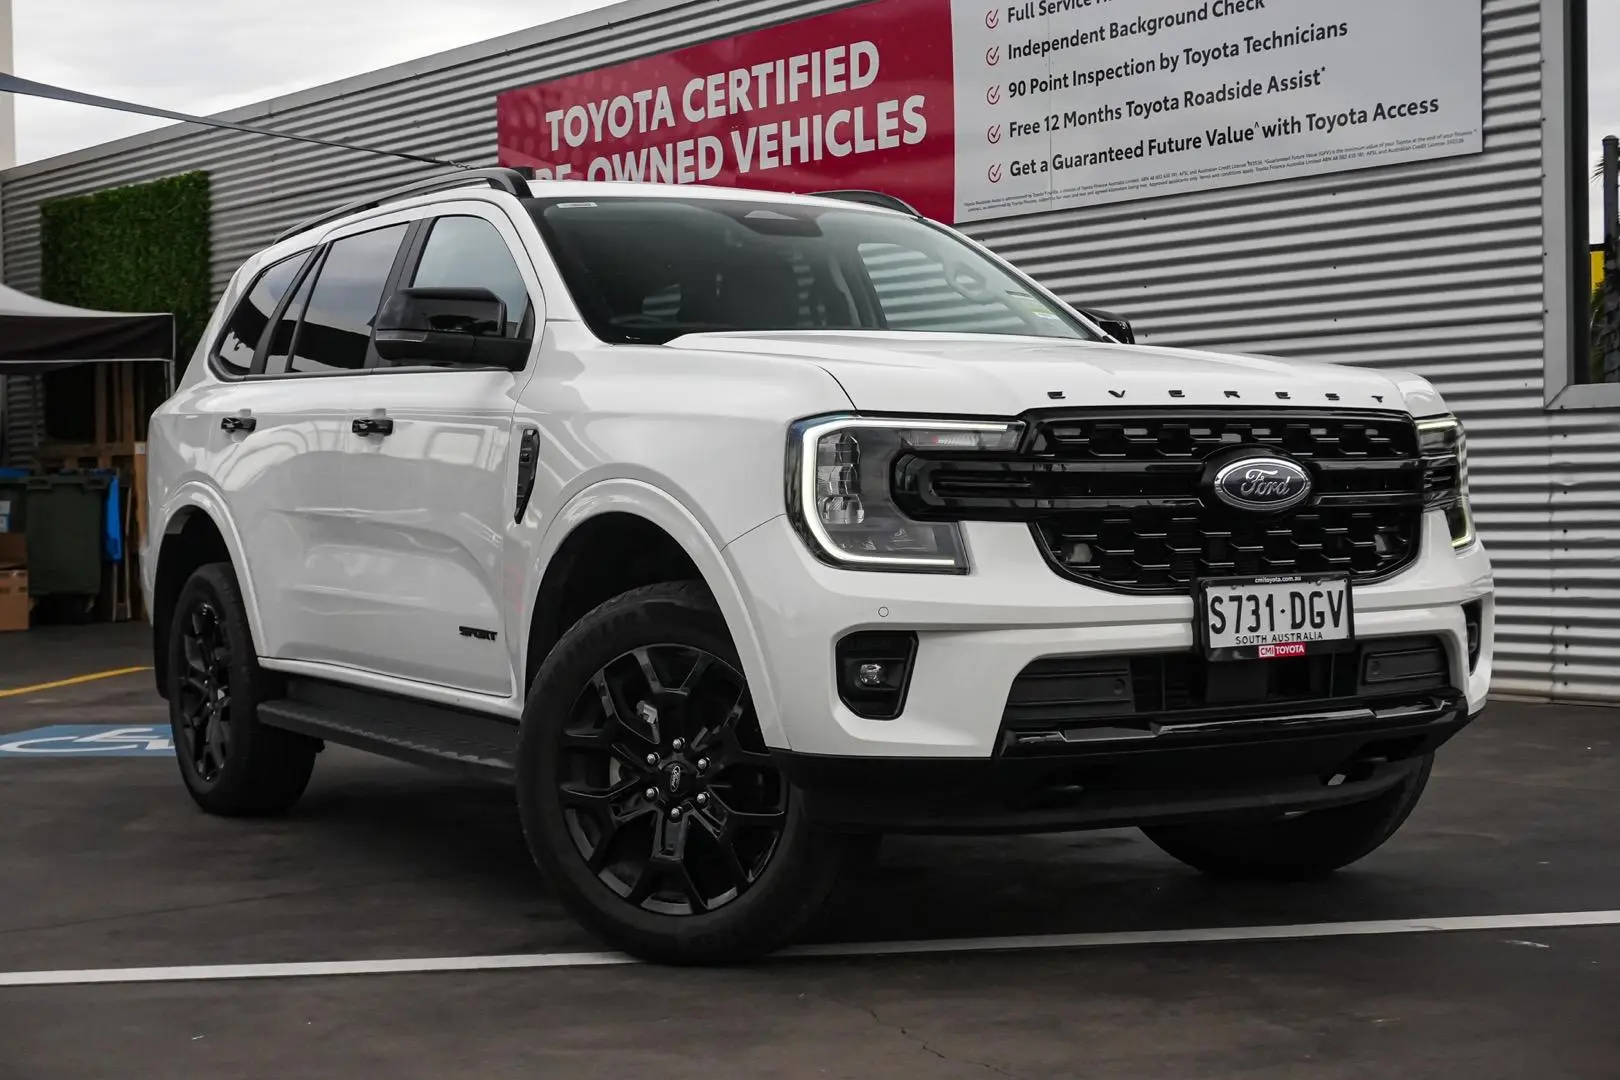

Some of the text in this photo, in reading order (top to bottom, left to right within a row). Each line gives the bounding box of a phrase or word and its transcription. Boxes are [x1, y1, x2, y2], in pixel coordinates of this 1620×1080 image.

[1007, 2, 1035, 23] Full
[1008, 26, 1106, 59] Independent
[1110, 3, 1208, 38] Background
[1008, 22, 1348, 98] 90 Point Inspection by Toyota Technicians
[545, 40, 880, 152] TOYOTA CERTIFIED
[1009, 121, 1041, 138] Free
[1044, 114, 1060, 132] 12
[1063, 104, 1122, 129] Months
[1125, 95, 1179, 119] Toyota
[1184, 79, 1262, 108] Roadside
[730, 95, 928, 174] VEHICLES
[1010, 159, 1036, 177] Get
[1040, 161, 1049, 173] a
[1052, 140, 1144, 171] Guaranteed
[1148, 136, 1202, 156] Future
[1262, 115, 1301, 138] with
[1306, 108, 1368, 133] Toyota
[1372, 98, 1439, 122] Access
[1047, 389, 1384, 403] EVEREST
[1240, 468, 1292, 497] Ford
[1235, 631, 1323, 645] SOUTH AUSTRALIA
[1259, 644, 1305, 657] CMI TOYOTA
